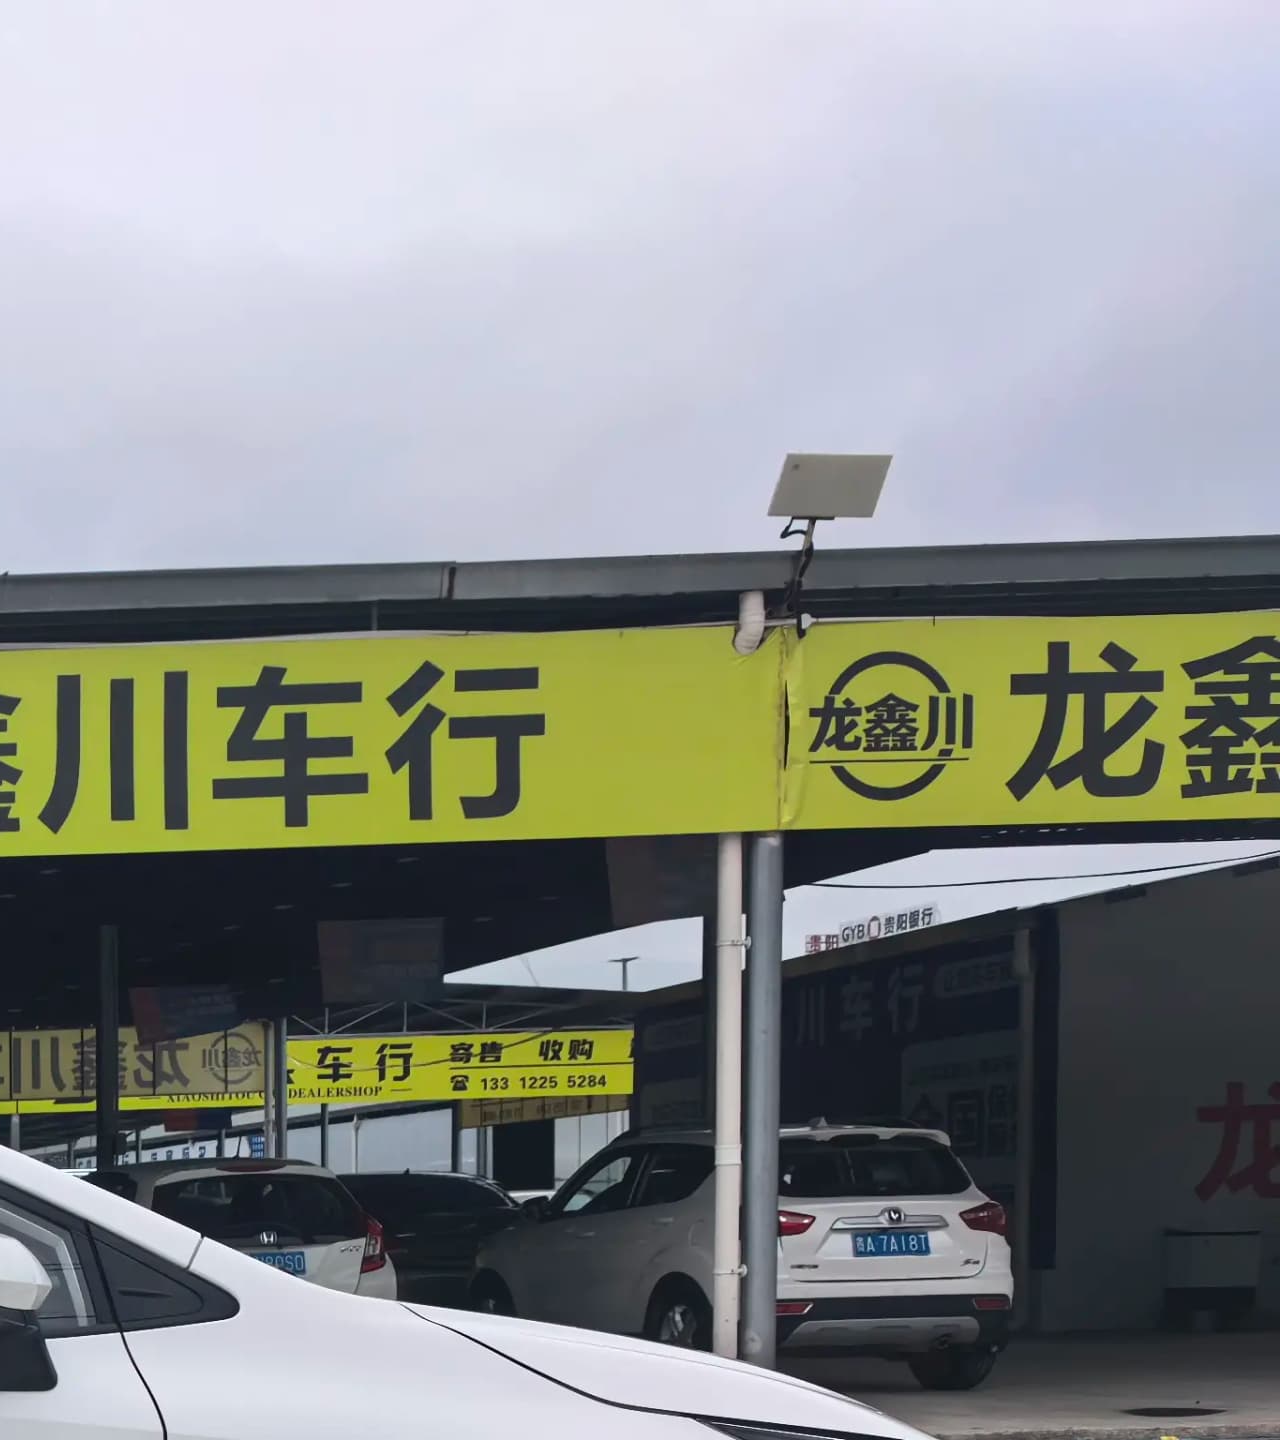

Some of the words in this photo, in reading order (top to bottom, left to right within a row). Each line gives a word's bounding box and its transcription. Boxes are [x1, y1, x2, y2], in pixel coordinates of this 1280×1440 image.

[808, 692, 974, 752] 龙鑫川
[842, 924, 865, 942] GYB
[883, 907, 934, 935] 贵阳银行
[286, 1042, 413, 1083] 车行
[450, 1041, 504, 1064] 寄售
[538, 1039, 594, 1061] 收购
[289, 1086, 383, 1099] DEALERSHOP
[480, 1077, 509, 1091] 133
[520, 1076, 558, 1090] 1225
[567, 1074, 607, 1089] 5284
